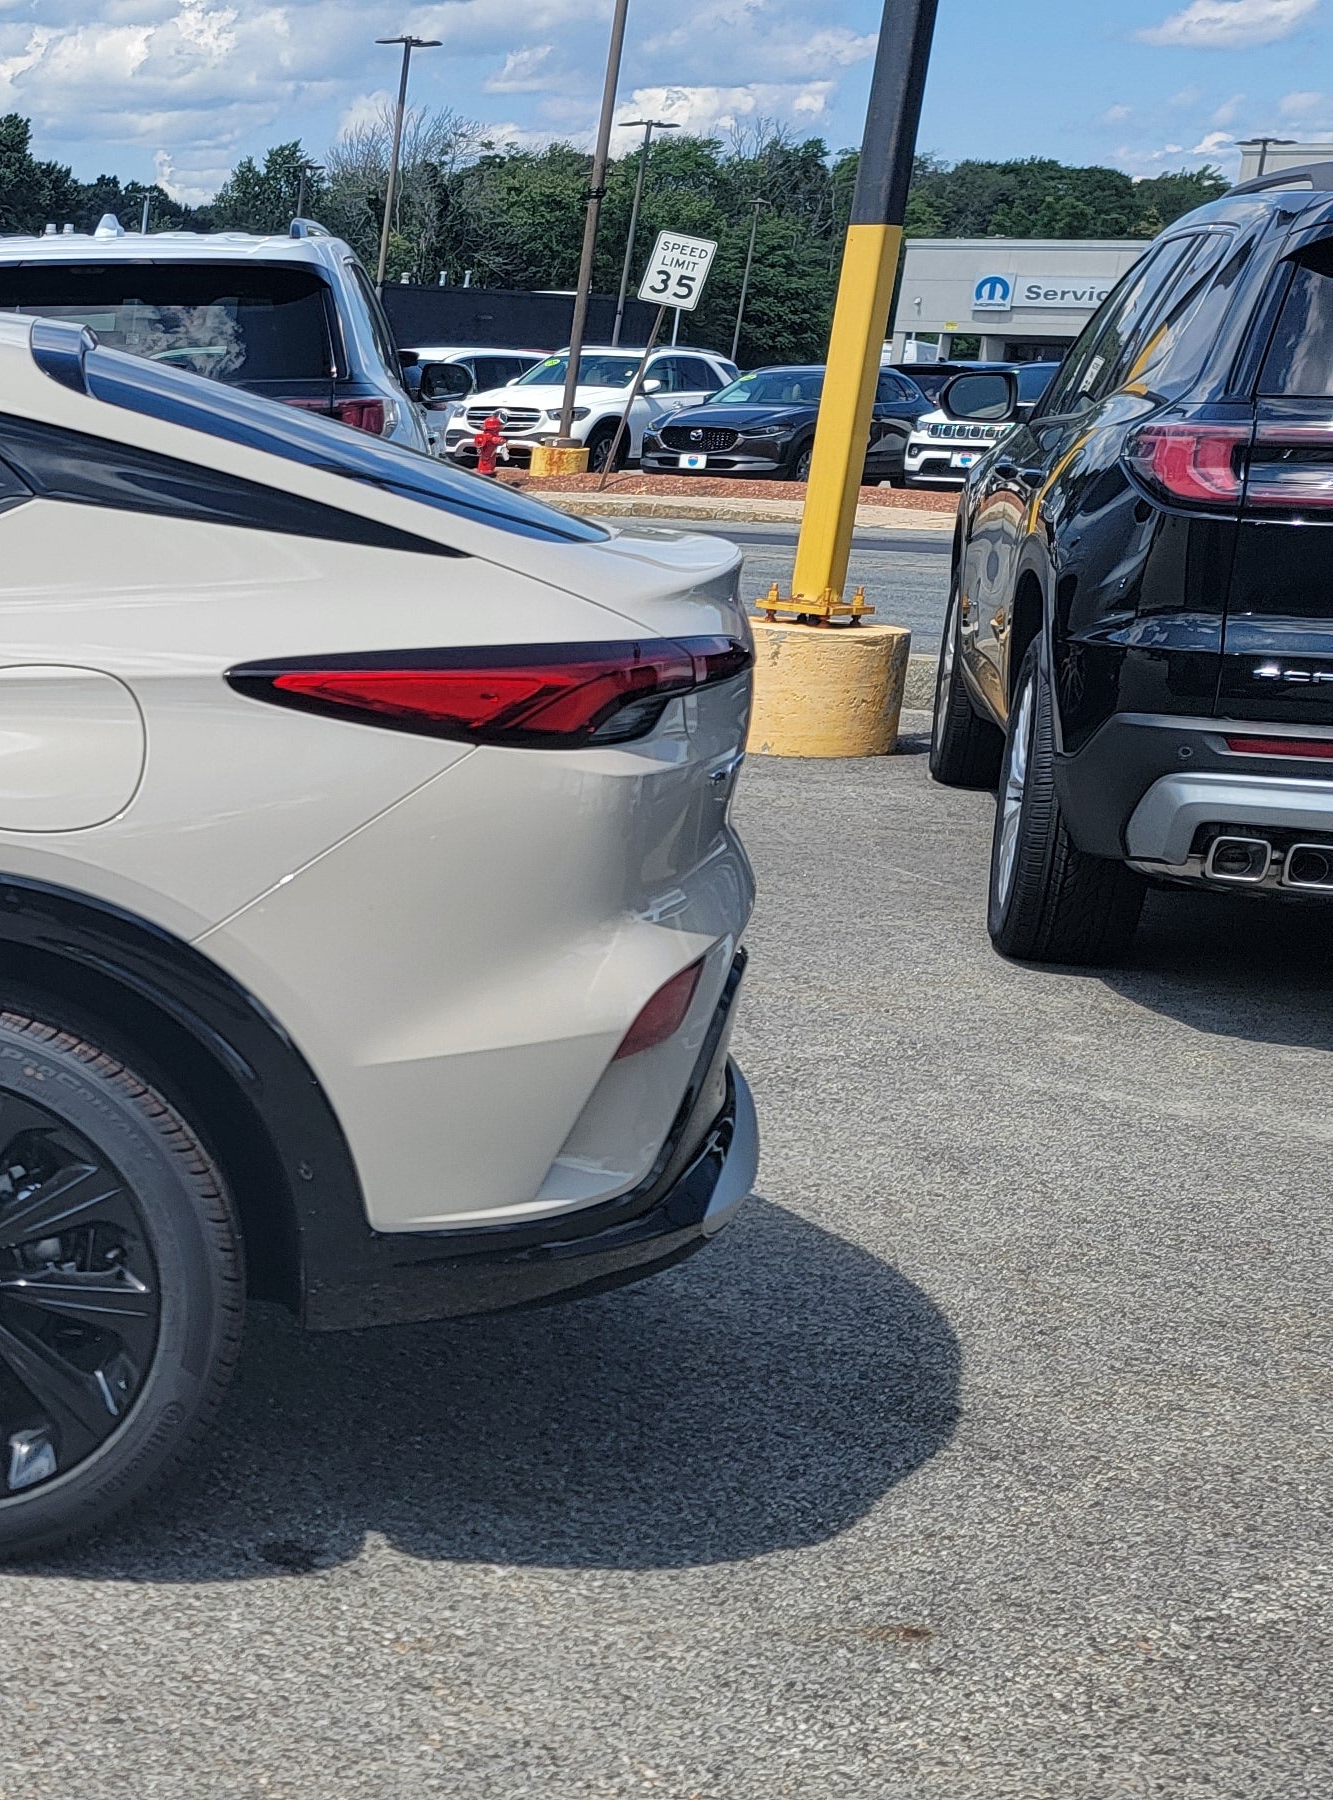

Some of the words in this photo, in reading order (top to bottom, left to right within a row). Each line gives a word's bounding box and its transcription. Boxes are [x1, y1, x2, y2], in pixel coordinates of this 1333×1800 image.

[660, 240, 709, 260] SPEED
[660, 255, 699, 272] LIMIT
[649, 269, 696, 300] 35
[1024, 284, 1110, 302] Servic
